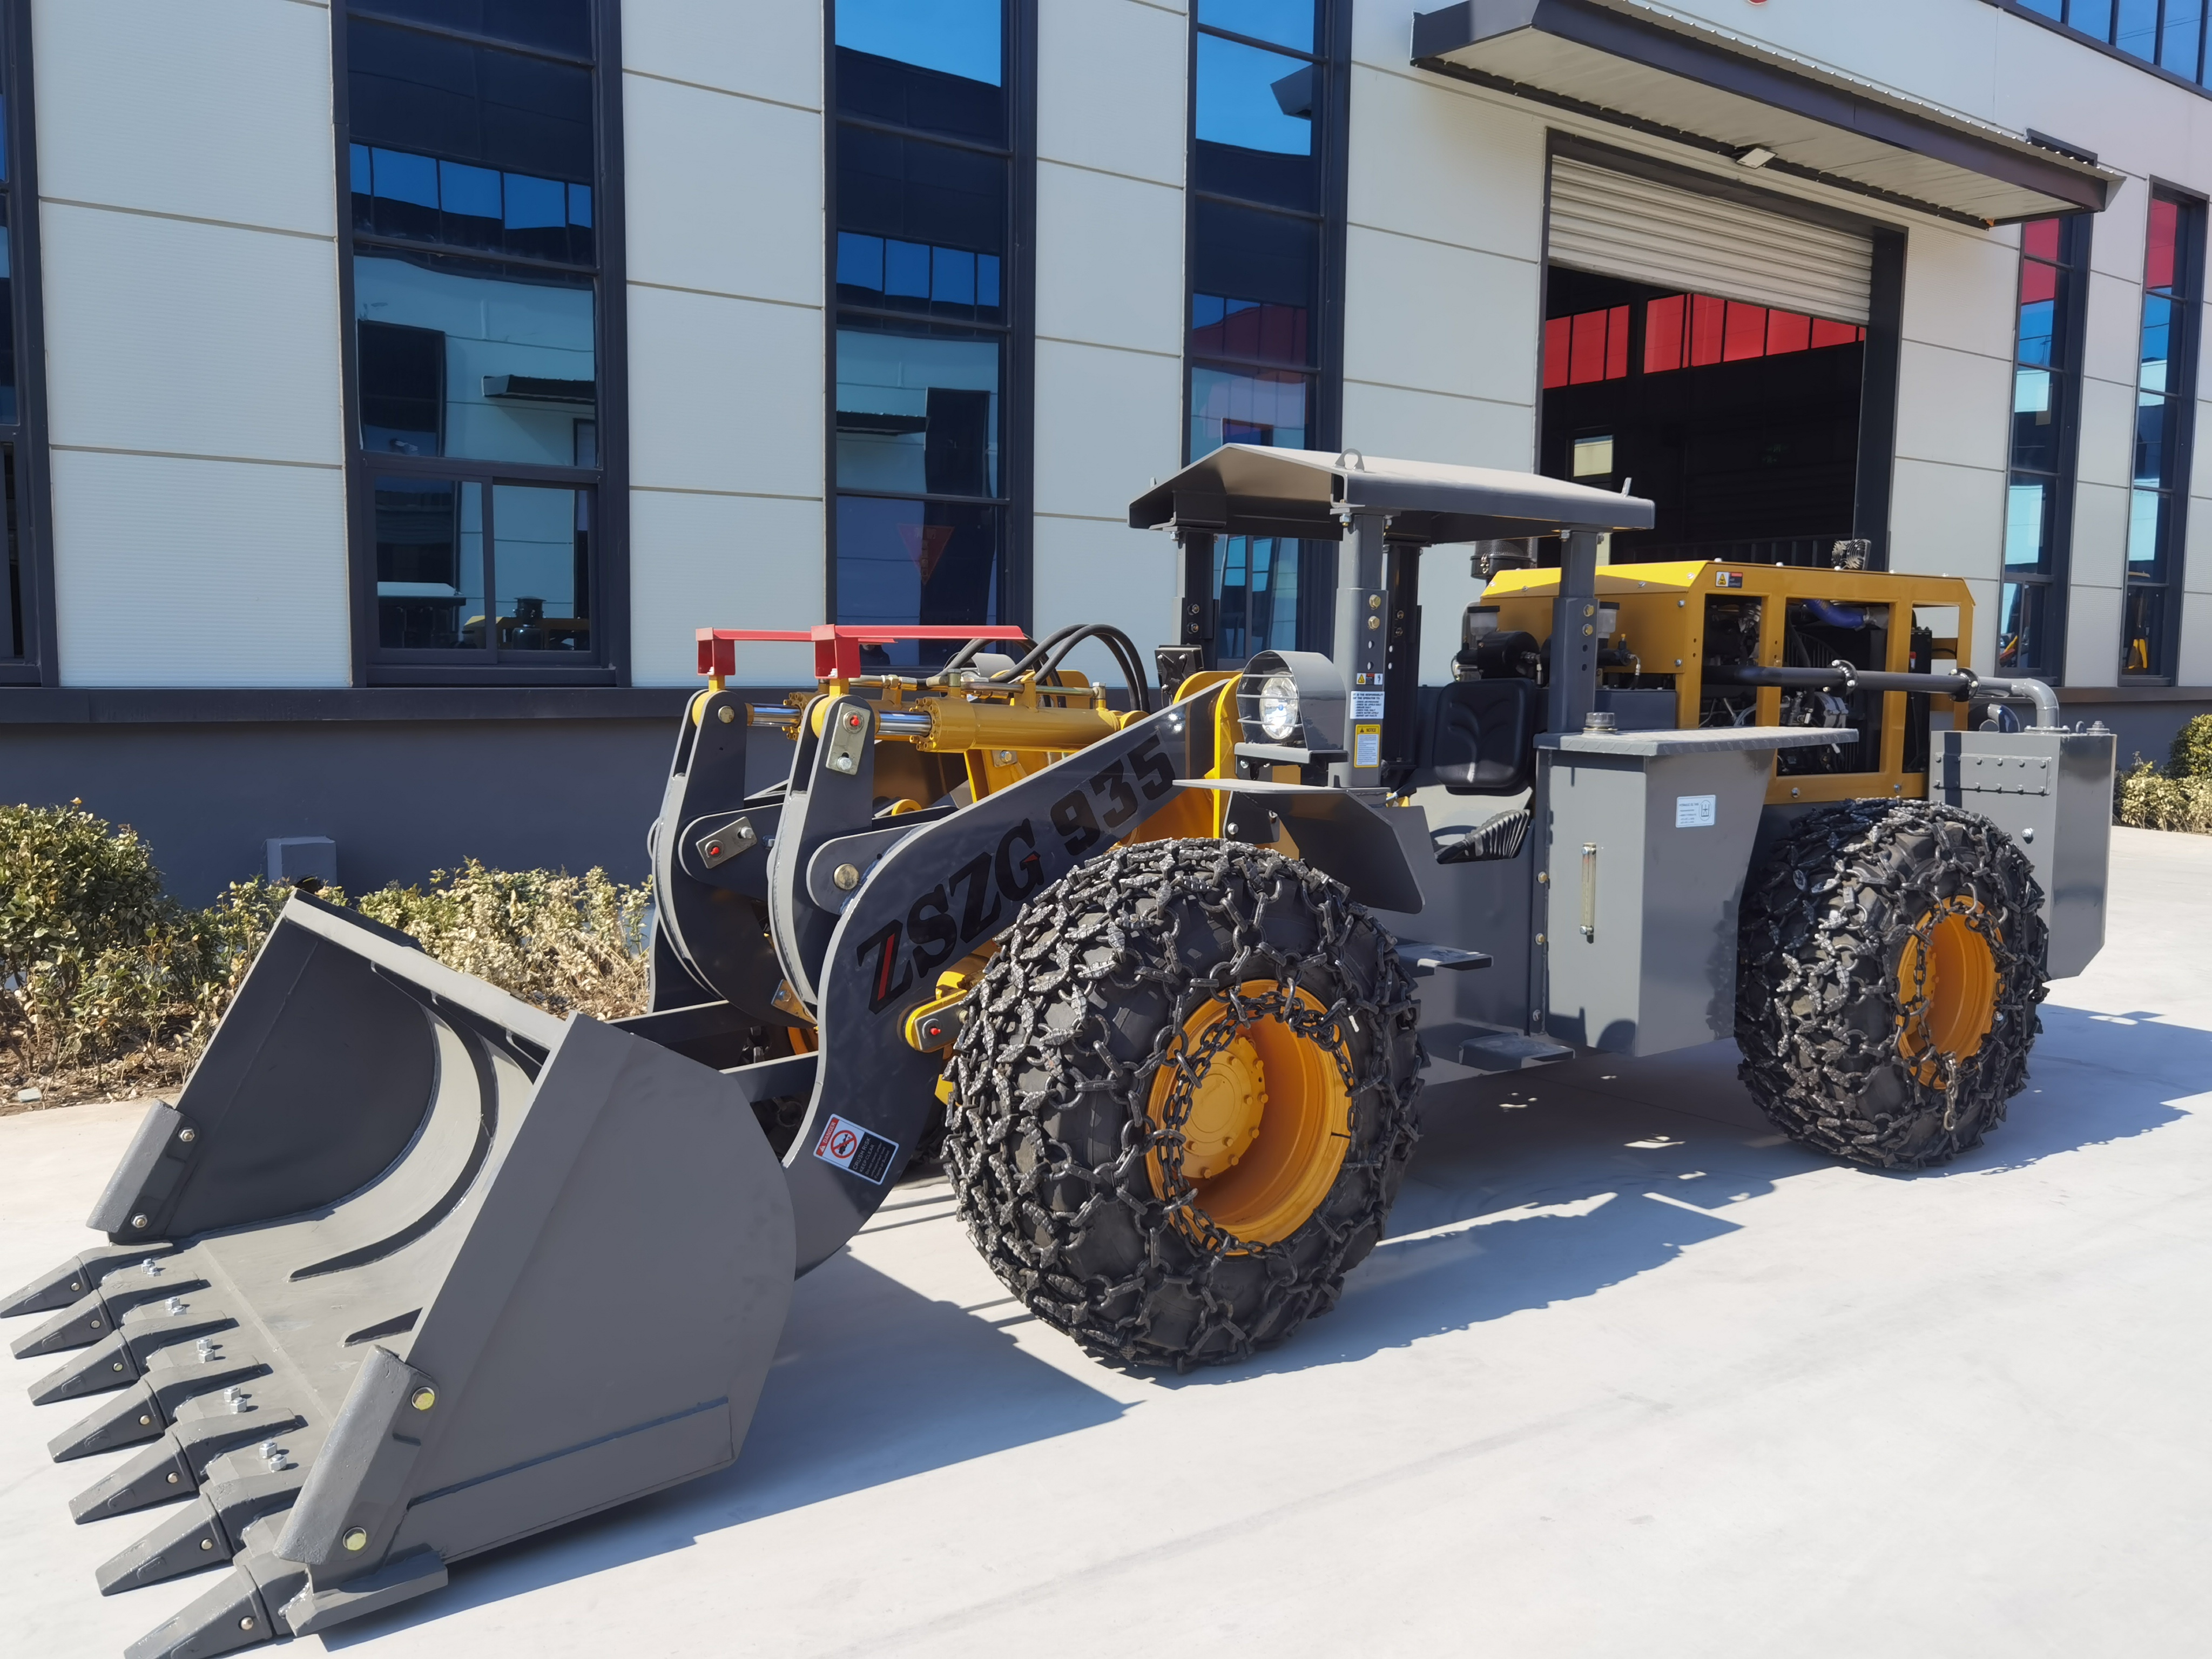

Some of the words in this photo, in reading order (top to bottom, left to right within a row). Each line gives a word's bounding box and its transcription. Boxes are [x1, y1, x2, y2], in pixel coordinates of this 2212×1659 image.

[857, 818, 1044, 1015] ZSZG
[1050, 735, 1176, 856] 935
[823, 1121, 837, 1143] DANGER
[853, 1150, 866, 1170] CRUSH
[862, 1136, 872, 1150] RISK
[859, 1159, 868, 1172] KEEP
[865, 1144, 875, 1160] CLEAR
